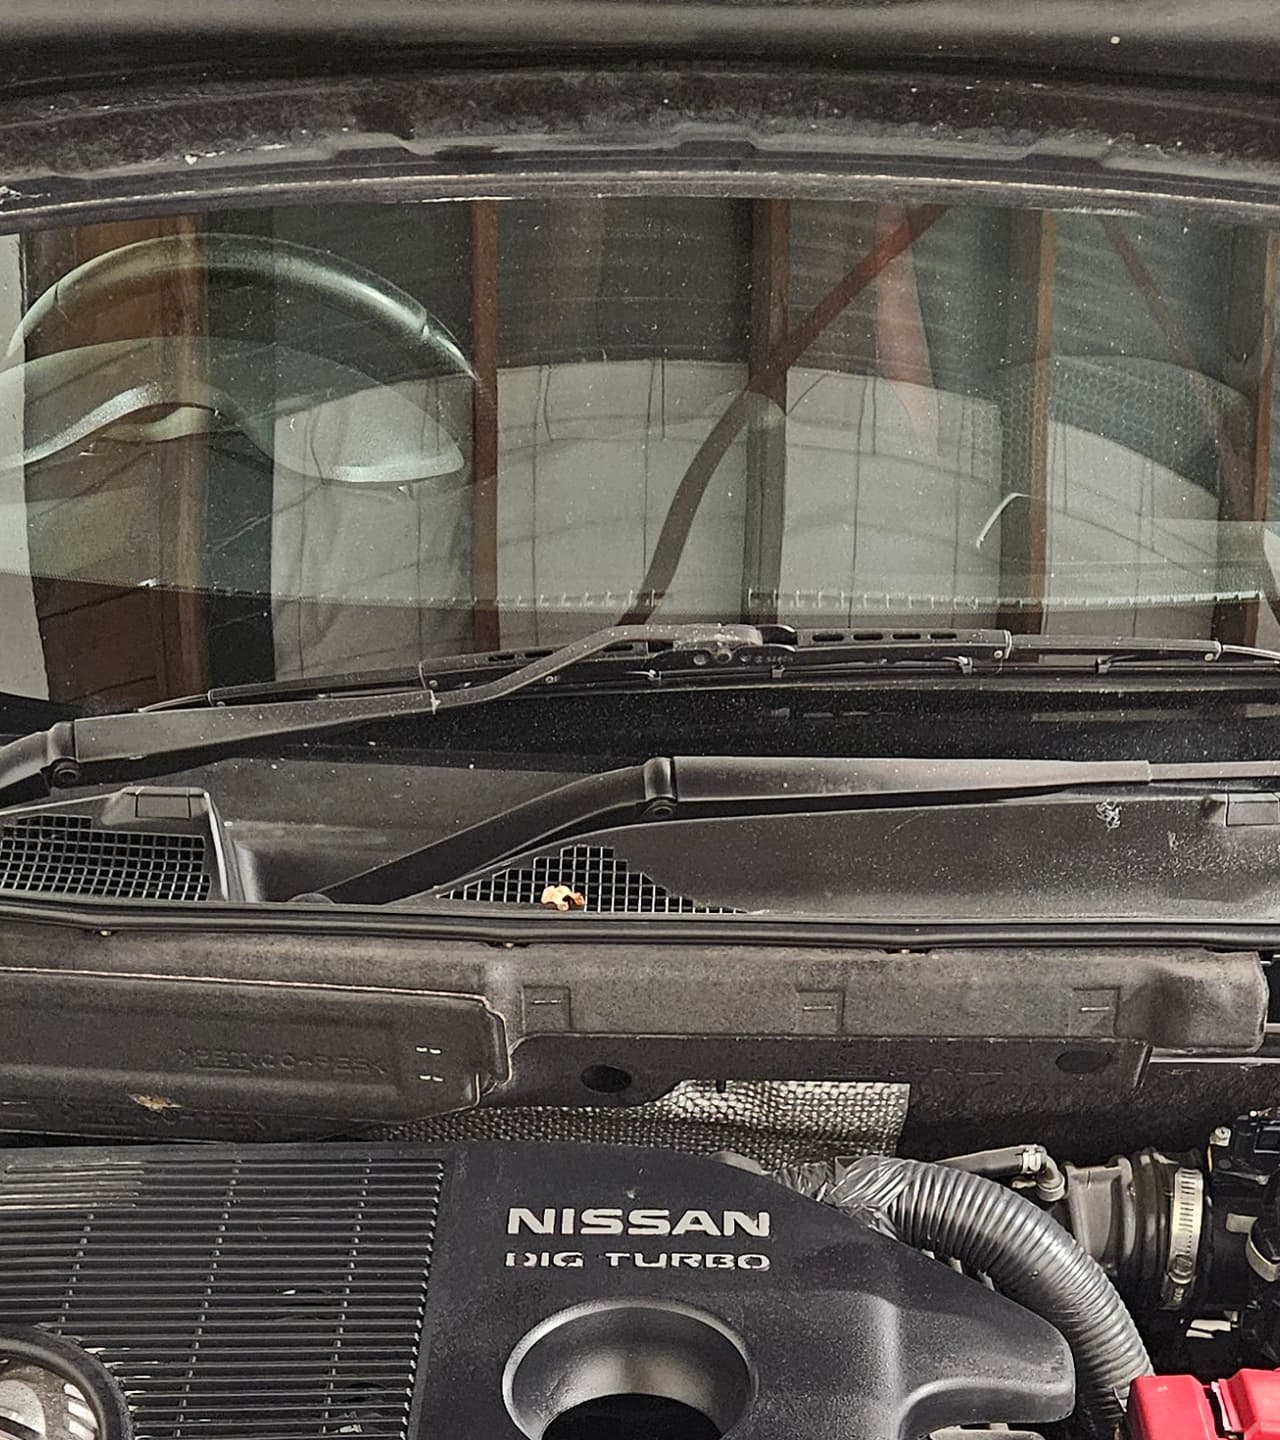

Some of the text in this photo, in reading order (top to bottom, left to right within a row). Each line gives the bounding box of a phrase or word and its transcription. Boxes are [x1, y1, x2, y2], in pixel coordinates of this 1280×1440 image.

[507, 1207, 771, 1238] NISSAN
[505, 1252, 771, 1271] DIG TURBO
